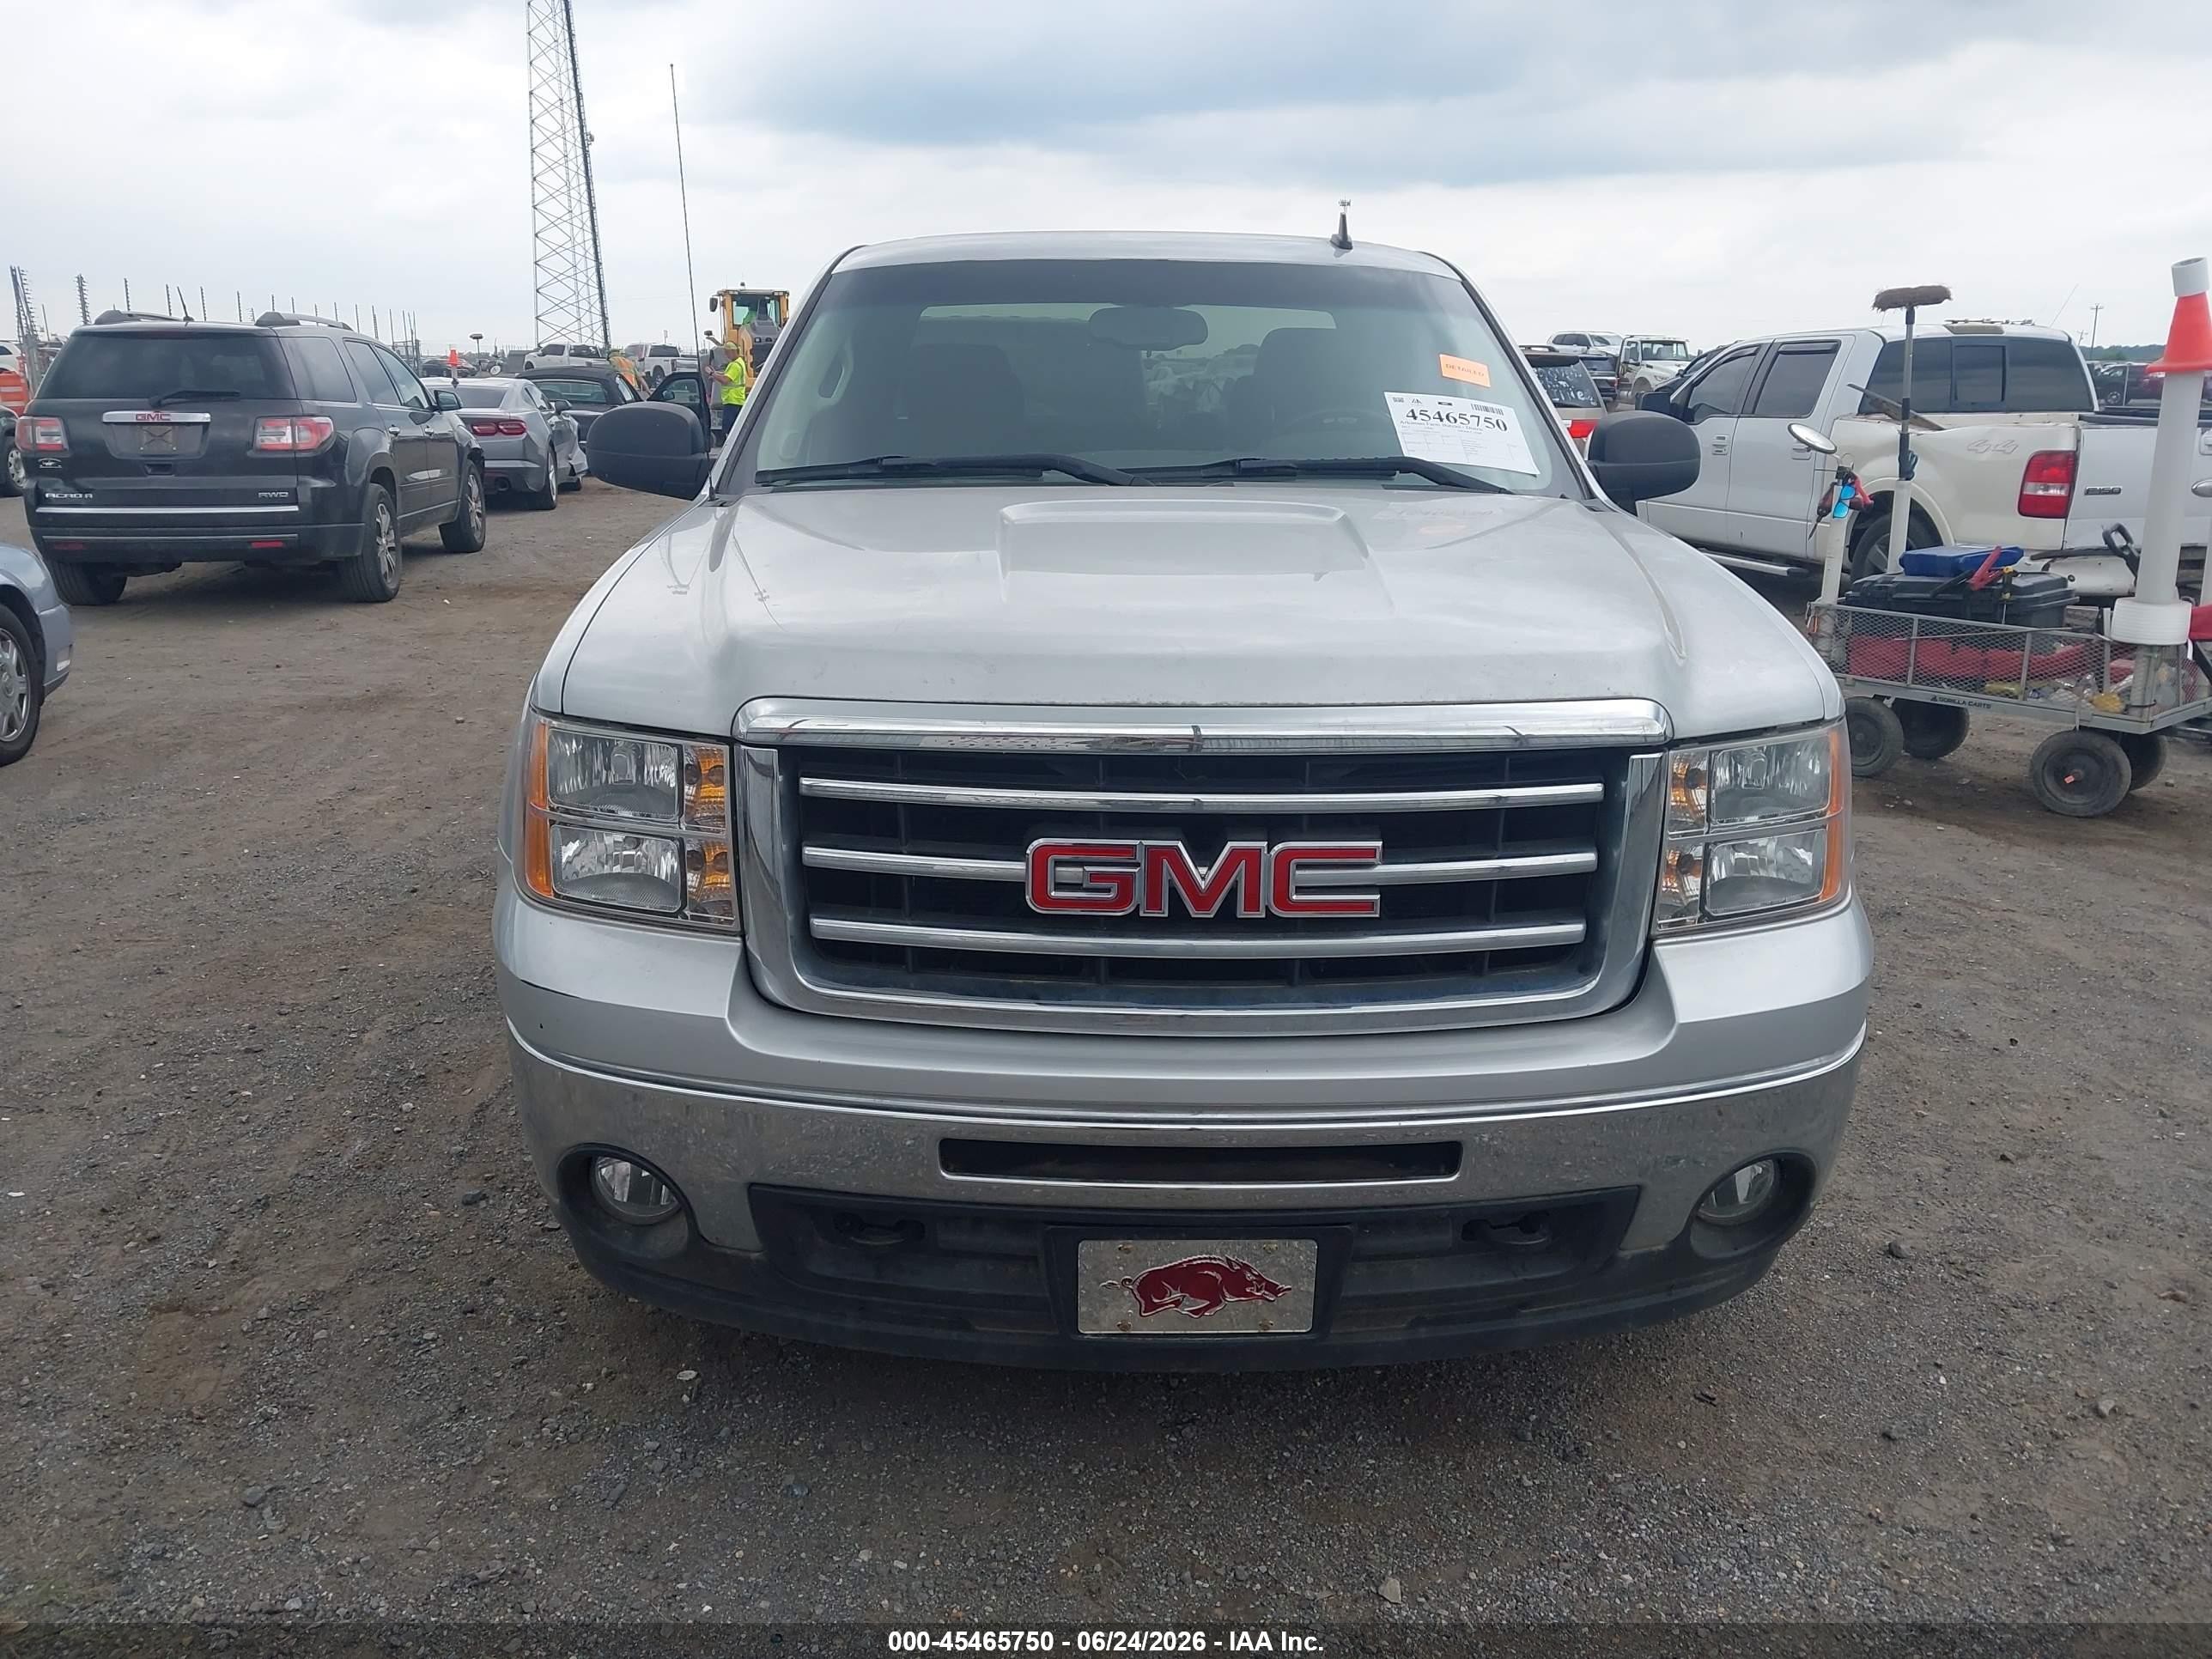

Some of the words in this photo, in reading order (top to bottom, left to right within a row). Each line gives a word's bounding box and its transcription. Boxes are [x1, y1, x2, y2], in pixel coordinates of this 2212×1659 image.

[136, 413, 172, 422] GMC
[1406, 409, 1508, 432] 45465750
[1967, 701, 1992, 710] CARTS
[1025, 837, 1382, 919] GMC
